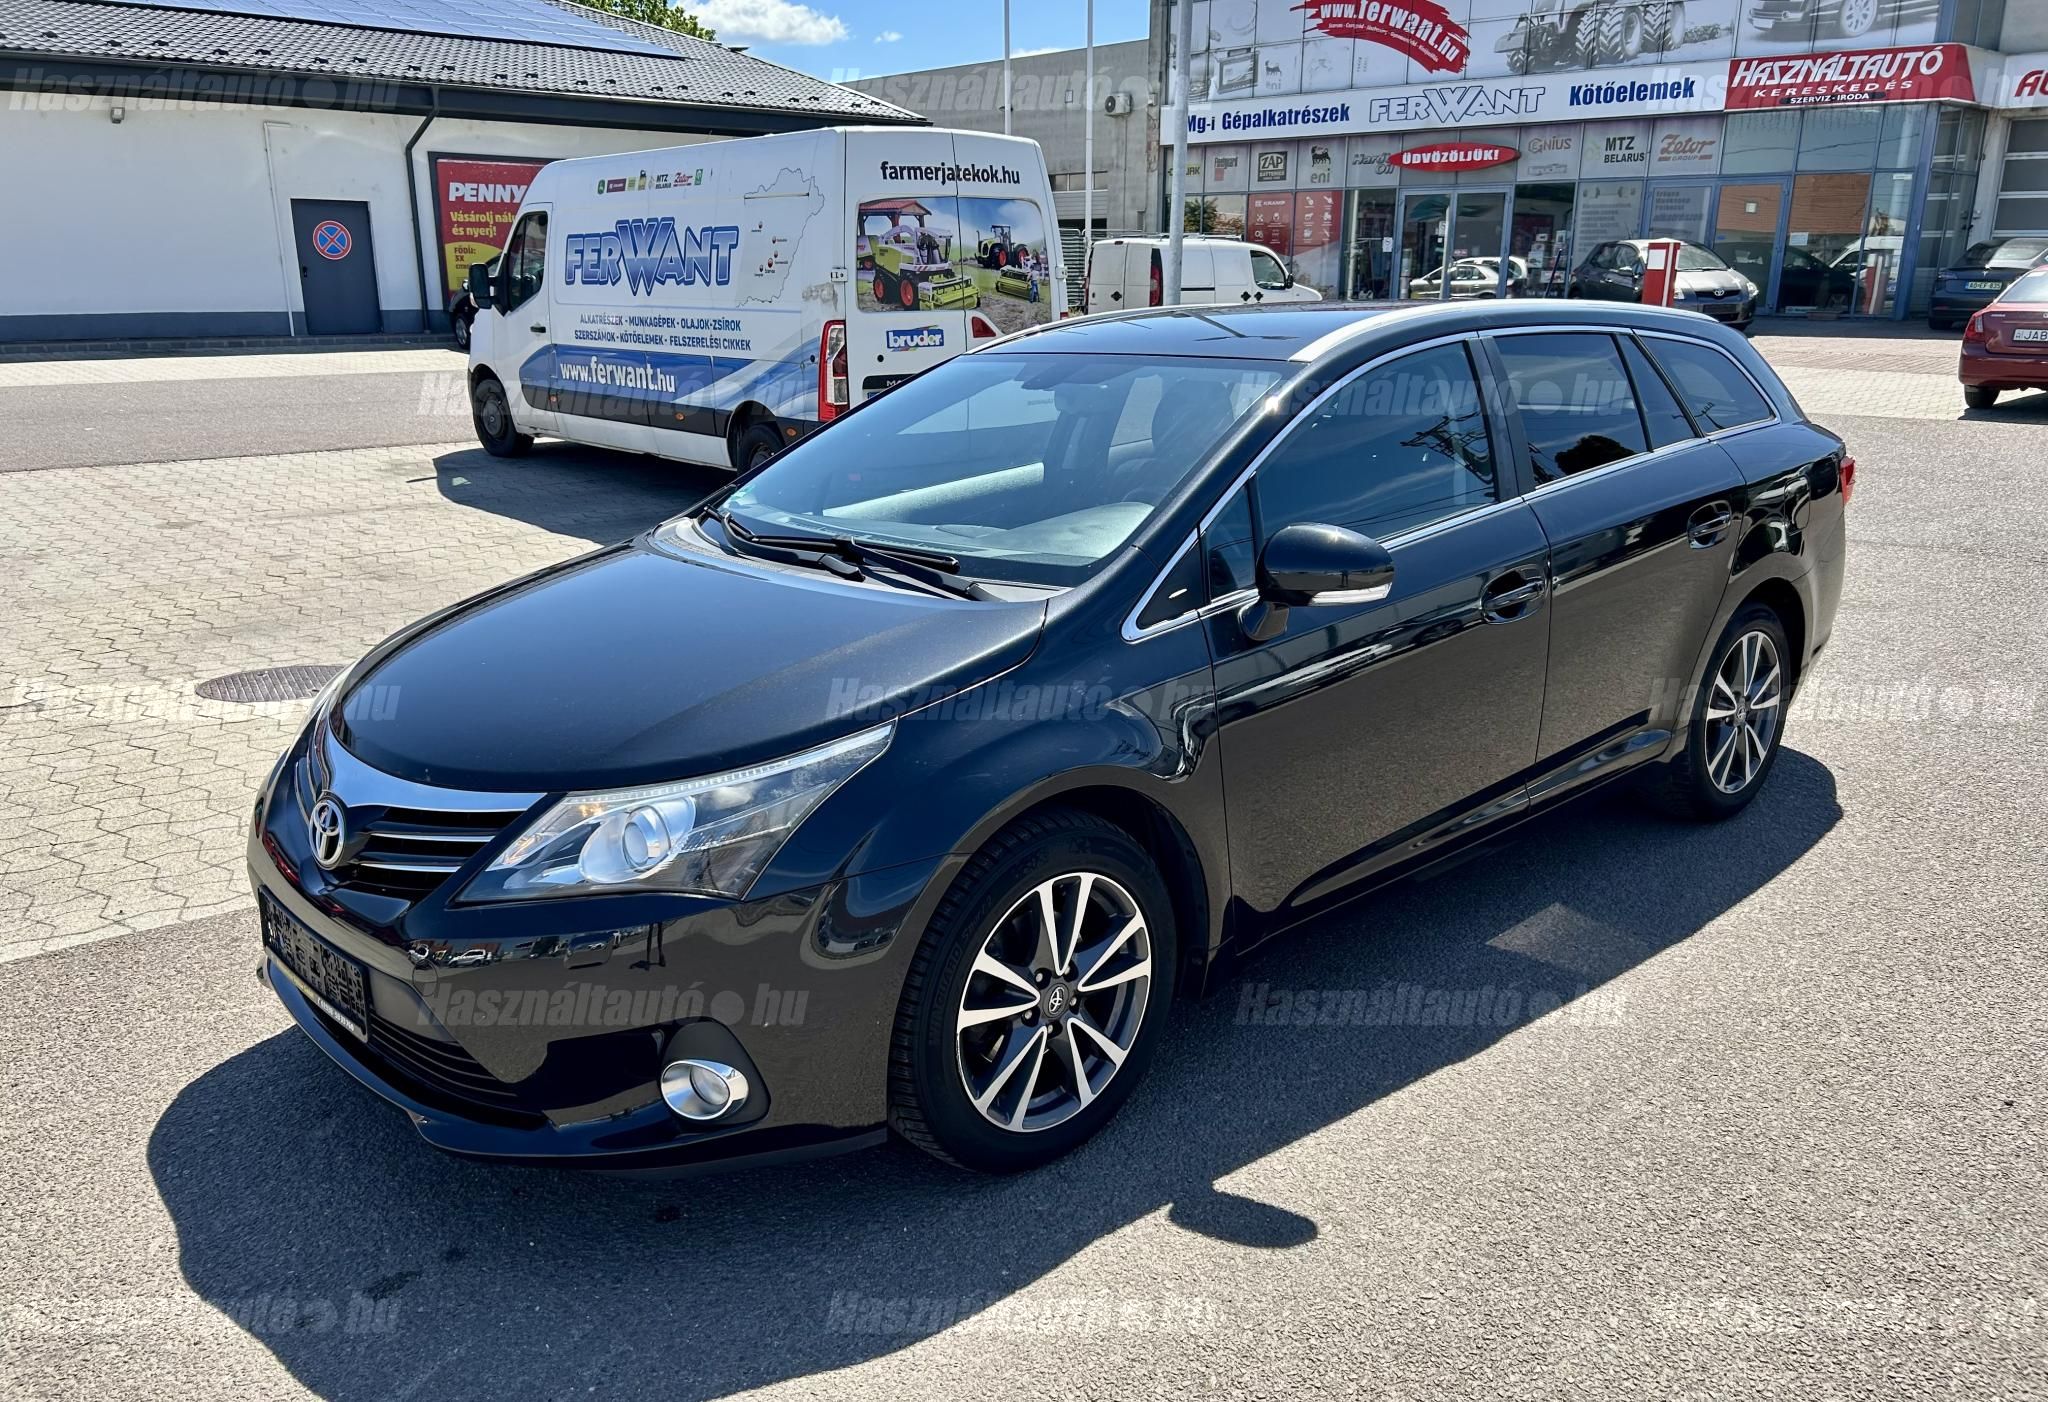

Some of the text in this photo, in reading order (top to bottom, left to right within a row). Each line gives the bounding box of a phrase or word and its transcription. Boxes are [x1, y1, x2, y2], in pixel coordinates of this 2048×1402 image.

[1731, 45, 1944, 88] HASZNÁLTAUTÓ
[1569, 76, 1696, 108] Kötőelemek
[1754, 79, 1913, 98] KERESKEDÉS
[1221, 103, 1350, 131] Gépalkatrészek
[1605, 136, 1636, 151] MTZ
[1660, 133, 1716, 155] Zetor
[1261, 155, 1284, 170] ZAP
[1402, 148, 1500, 165] ÜDVÖZÖLJÜK!
[1604, 152, 1646, 164] BELARUS
[880, 161, 1020, 185] farmerjatekok.hu
[1310, 168, 1331, 184] eni
[448, 182, 527, 203] PENNY
[452, 223, 497, 238] és nyerj!
[565, 216, 740, 297] FERWANT
[580, 313, 623, 326] ALKATRÉSZEK
[669, 335, 722, 350] FELSZERELÉSI
[722, 338, 752, 352] CIKKEK
[888, 331, 942, 348] bruder
[560, 356, 677, 393] www.ferwant.hu
